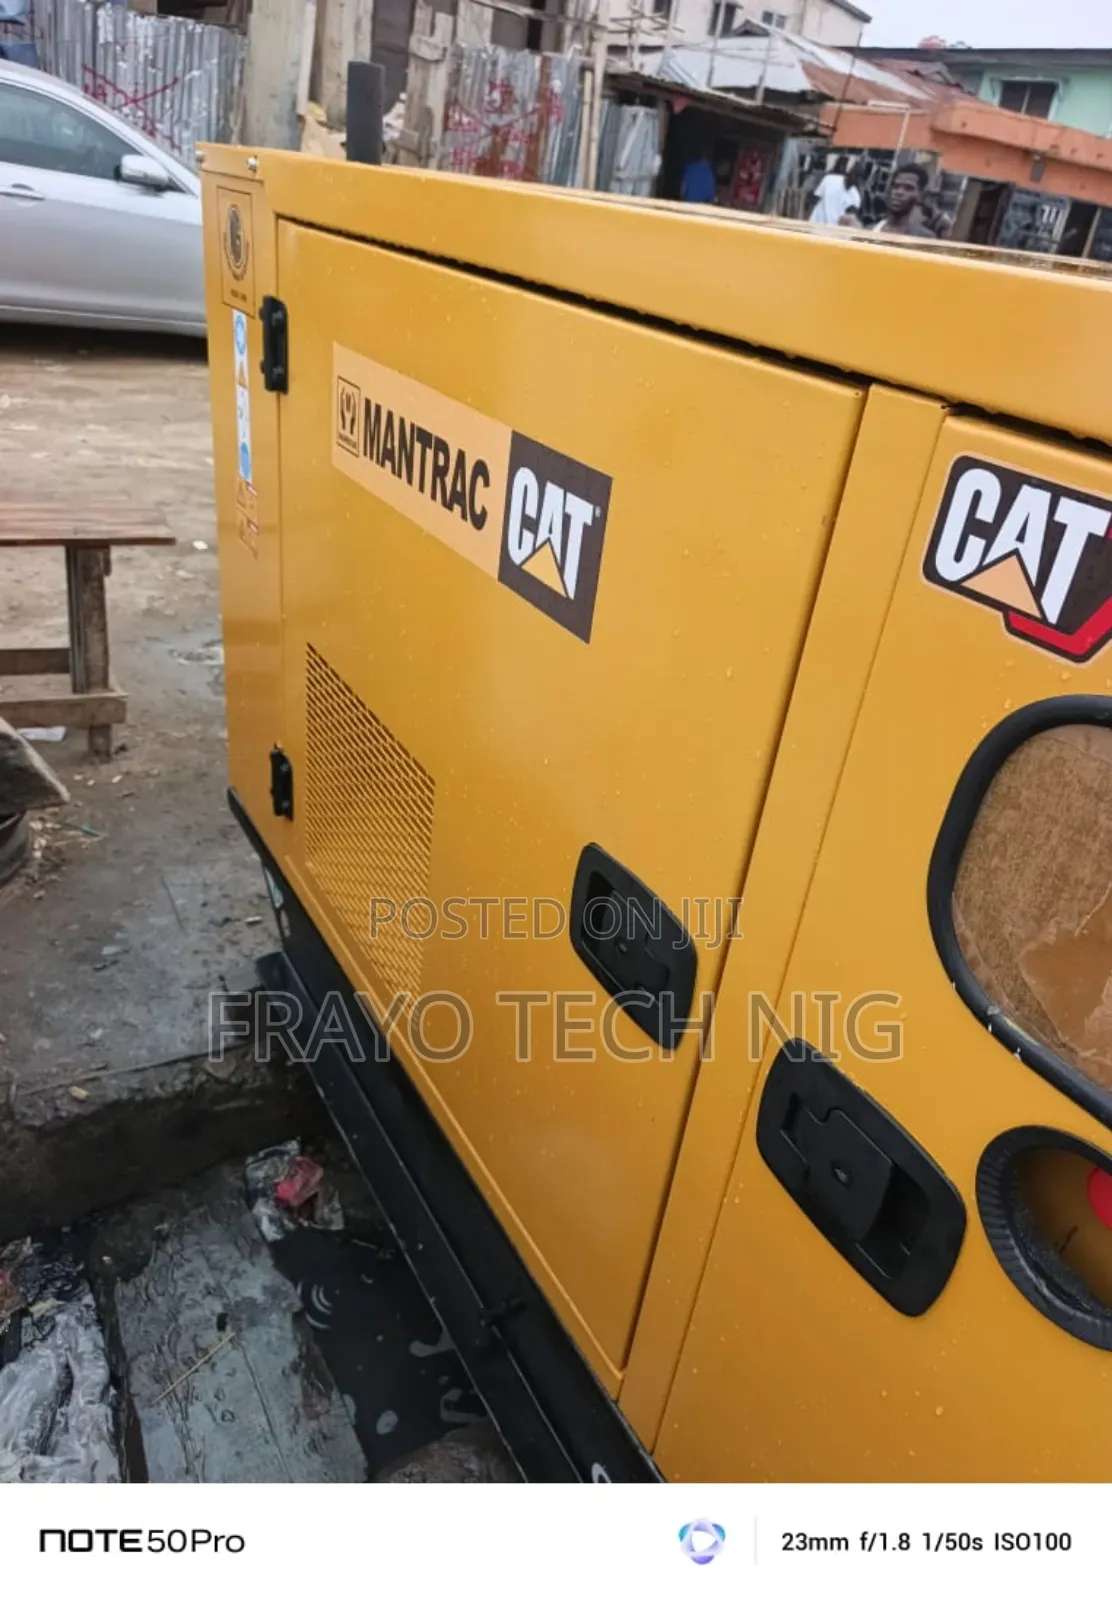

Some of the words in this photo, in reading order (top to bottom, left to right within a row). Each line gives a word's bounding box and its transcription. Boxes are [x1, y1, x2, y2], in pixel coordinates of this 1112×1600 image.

[363, 397, 490, 531] MANTRAC
[508, 466, 595, 600] CAT
[935, 468, 1112, 626] CAT
